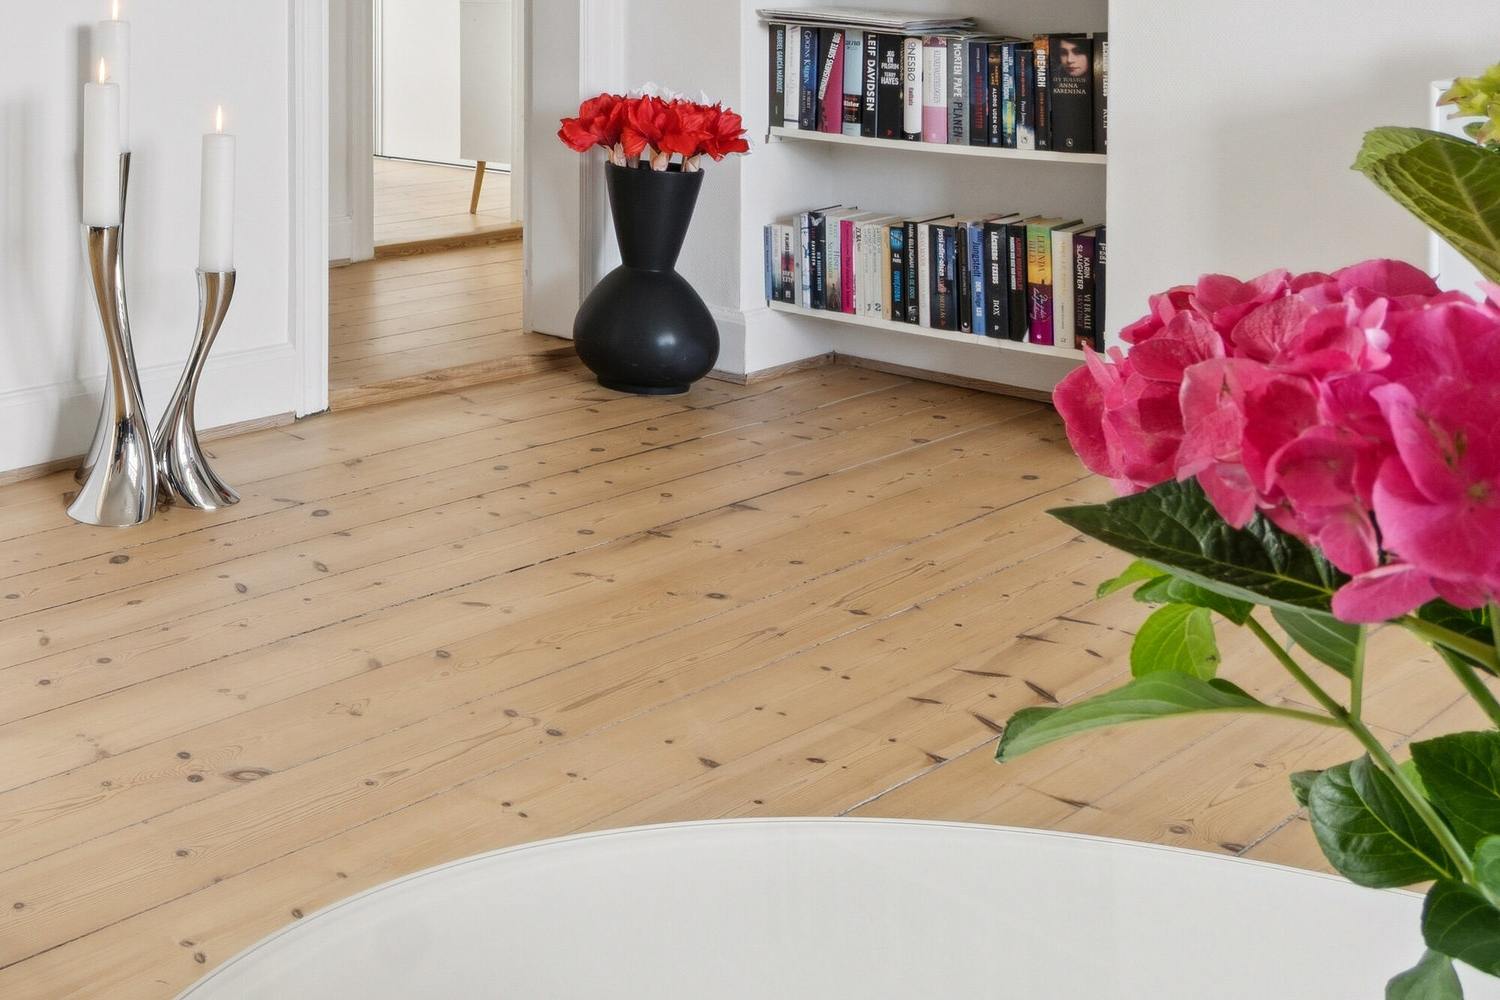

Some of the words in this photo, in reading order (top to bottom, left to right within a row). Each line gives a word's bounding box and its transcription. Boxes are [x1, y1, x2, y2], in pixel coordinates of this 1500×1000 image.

[776, 29, 784, 51] GABRIEL
[866, 33, 876, 57] LEIF
[907, 47, 916, 82] NESBØ
[953, 42, 963, 75] MORTEN
[776, 69, 784, 94] MÁRQUEZ
[866, 58, 877, 112] DAVIDSEN
[879, 77, 899, 86] HAYES
[953, 76, 963, 98] PAPE
[953, 101, 964, 138] PLANEN
[936, 227, 945, 243] jussi
[990, 231, 999, 261] LÄCKBERG
[937, 243, 946, 277] adler-olsen
[972, 241, 982, 278] Jungstedt
[1037, 235, 1046, 273] LUCINDA
[991, 262, 1000, 285] FEXEUS
[1076, 243, 1084, 290] SLAUGHTER
[1083, 256, 1091, 279] KARIN
[874, 302, 882, 312] 2
[992, 299, 1001, 316] BOX
[1084, 293, 1091, 302] VI
[1084, 303, 1092, 313] ER
[1084, 314, 1092, 330] ALLE
